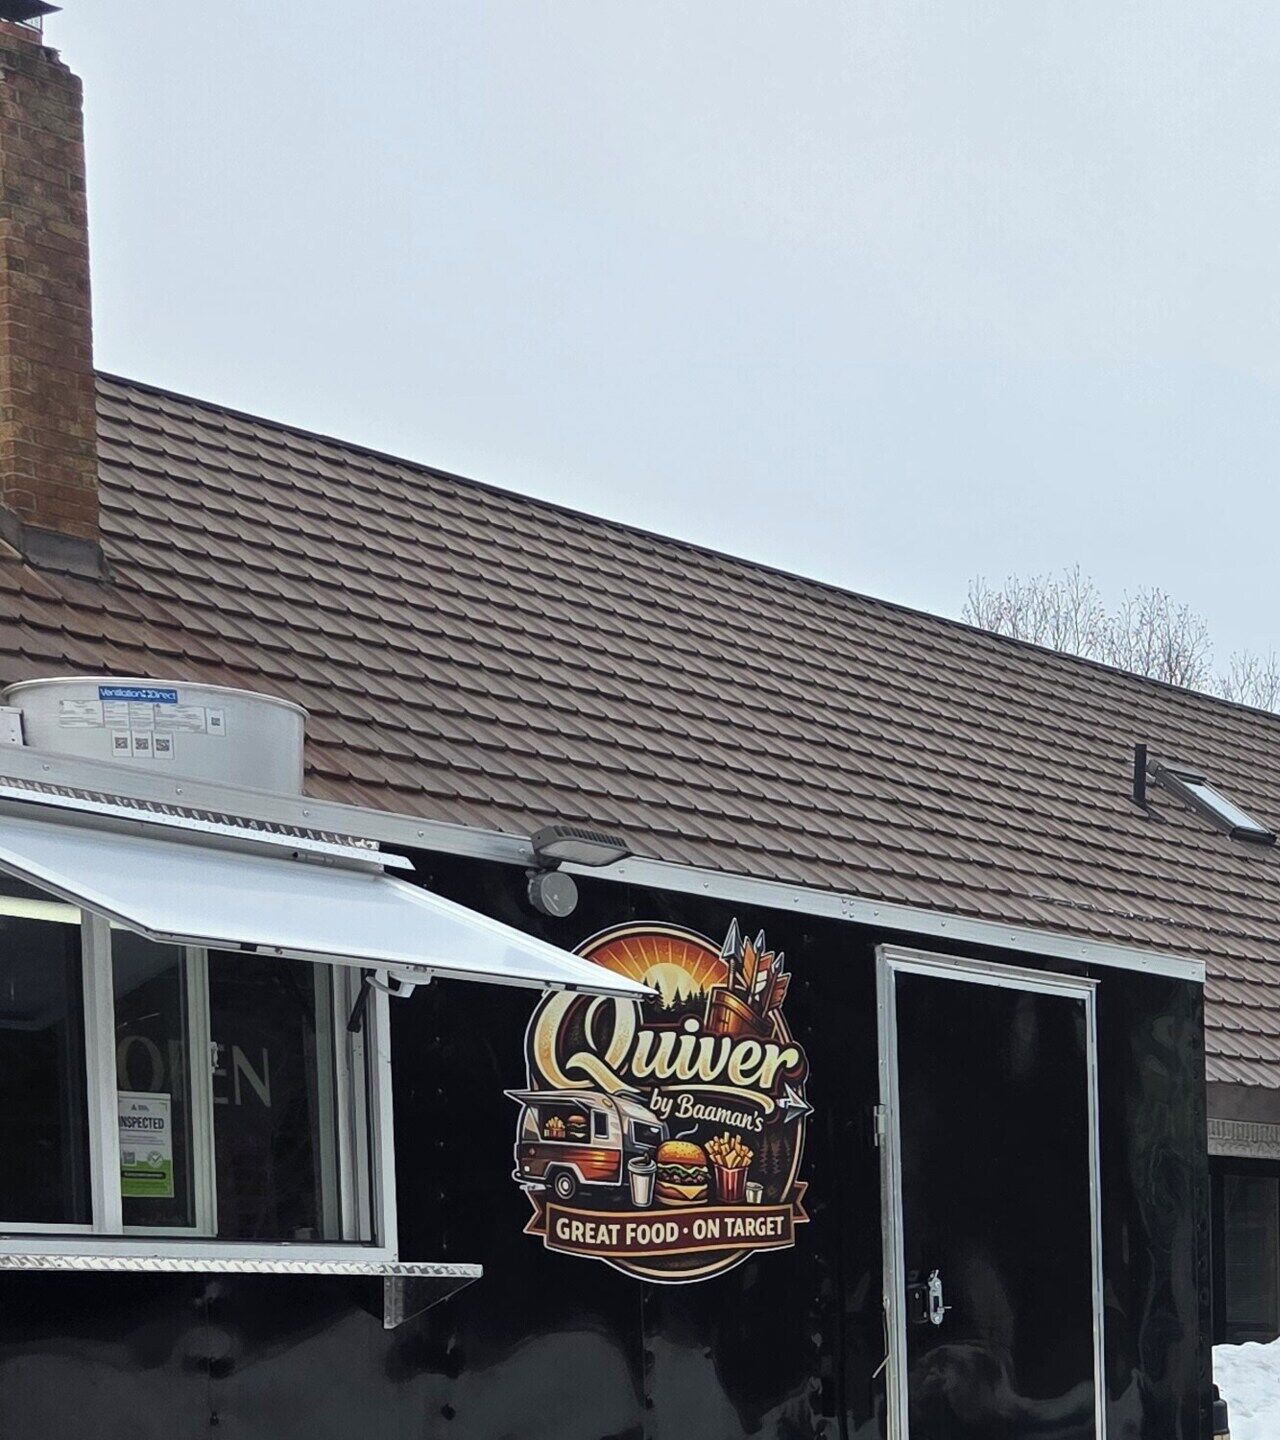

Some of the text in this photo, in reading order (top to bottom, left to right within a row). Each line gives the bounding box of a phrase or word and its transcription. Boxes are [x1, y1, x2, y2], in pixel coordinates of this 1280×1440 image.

[534, 990, 799, 1093] Quiver
[117, 1035, 272, 1108] ON
[119, 1115, 165, 1130] NSPECTED
[649, 1087, 763, 1132] by Baaman's
[555, 1215, 785, 1246] GREAT FOOD ON TARGET
